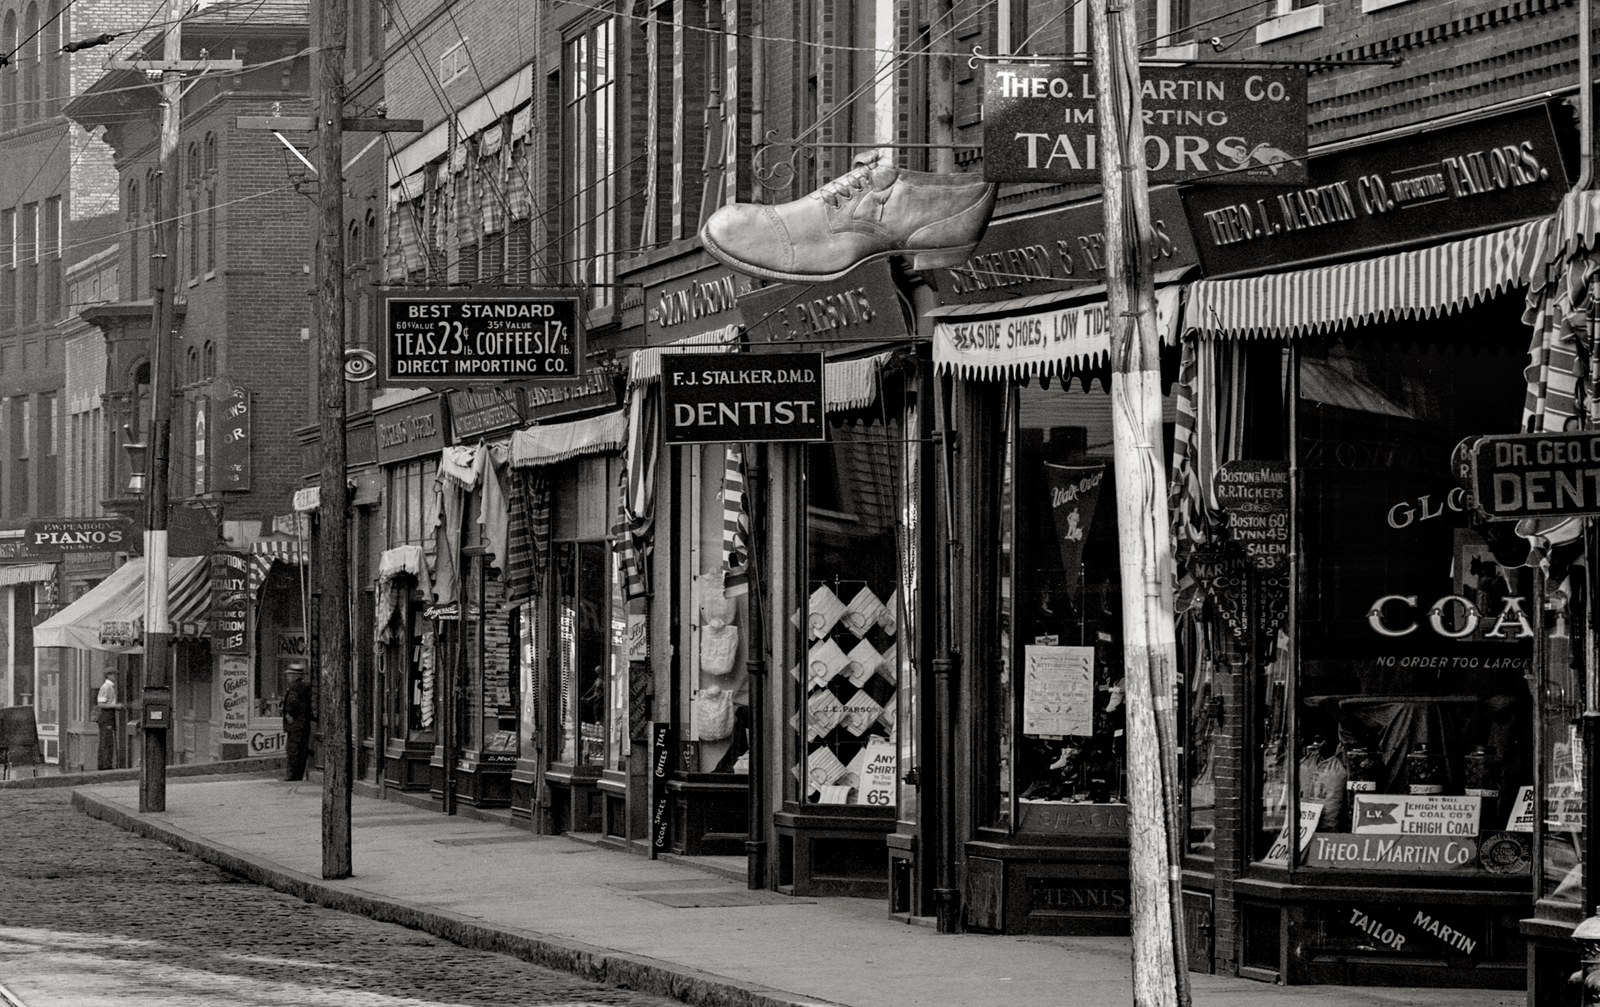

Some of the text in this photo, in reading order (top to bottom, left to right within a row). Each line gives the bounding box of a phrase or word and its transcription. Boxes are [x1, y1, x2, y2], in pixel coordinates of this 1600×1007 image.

[997, 71, 1073, 99] THEO.
[1141, 80, 1224, 101] ARTIN
[1065, 109, 1228, 126] IMRTING
[1015, 132, 1250, 172] TAIORS
[1203, 141, 1549, 245] THEO. L. MARTIN CO. IMPORTING TAILORS.
[409, 304, 555, 318] BEST STANDARD
[412, 322, 435, 330] VALUE
[505, 321, 532, 329] VALUE
[955, 322, 1000, 349] SEASIDE
[1007, 318, 1047, 348] SHOES,
[1054, 310, 1079, 343] LOW
[395, 332, 435, 356] TEAS
[476, 331, 542, 355] COFFEES
[397, 358, 568, 374] DIRECT IMPORTING CO.
[702, 370, 776, 385] STALKER,
[674, 401, 816, 427] DENTIST.
[1495, 442, 1533, 467] DR.
[1537, 440, 1587, 465] GEO.
[1221, 468, 1255, 484] BOSTON
[1261, 468, 1288, 484] MAINE
[1239, 486, 1284, 499] TICKETS
[1231, 513, 1266, 528] BOSTON
[35, 531, 122, 545] PIANOS
[1234, 528, 1266, 541] LYNN
[1247, 544, 1286, 556] SALEM
[1377, 656, 1395, 667] NO
[1401, 656, 1448, 668] ORDER
[1453, 657, 1479, 668] TOO
[224, 678, 248, 694] CIGARS
[223, 731, 247, 740] BRANDS
[252, 733, 286, 751] GET IT
[874, 754, 896, 764] ANY
[866, 763, 897, 774] SHIRT
[1351, 782, 1368, 790] EGG
[1366, 810, 1383, 818] L.V.
[1404, 802, 1437, 817] LEHIGH
[1401, 820, 1476, 835] LEHIGH COAL
[1317, 838, 1360, 861] THEO.
[1362, 838, 1376, 862] L.
[1376, 840, 1440, 863] MARTIN
[1044, 888, 1126, 907] TENNIS
[1350, 908, 1406, 951] TAILOR
[1413, 911, 1477, 955] MARTIN
